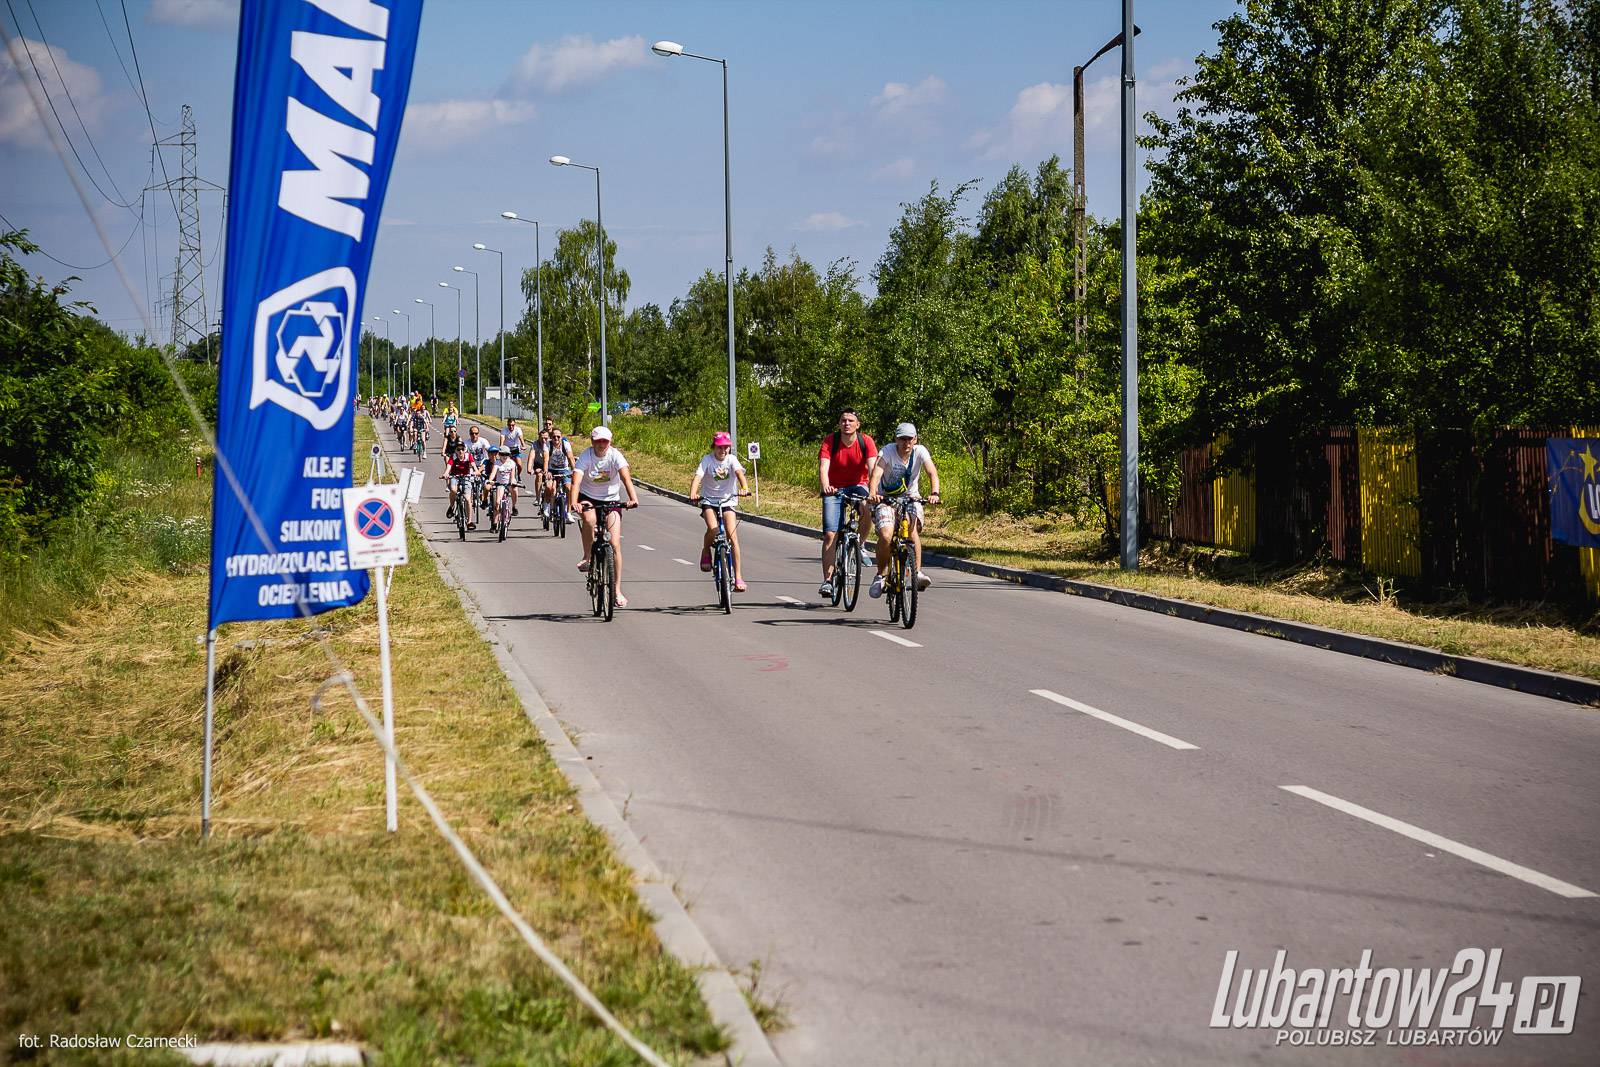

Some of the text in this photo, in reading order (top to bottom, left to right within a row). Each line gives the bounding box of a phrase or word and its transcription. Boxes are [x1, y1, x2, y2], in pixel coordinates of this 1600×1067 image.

[303, 457, 345, 478] KLEJE
[280, 520, 342, 542] SILIKONY
[225, 551, 348, 577] HYDROIZOLACJE
[258, 581, 354, 606] OCIEPLENIA
